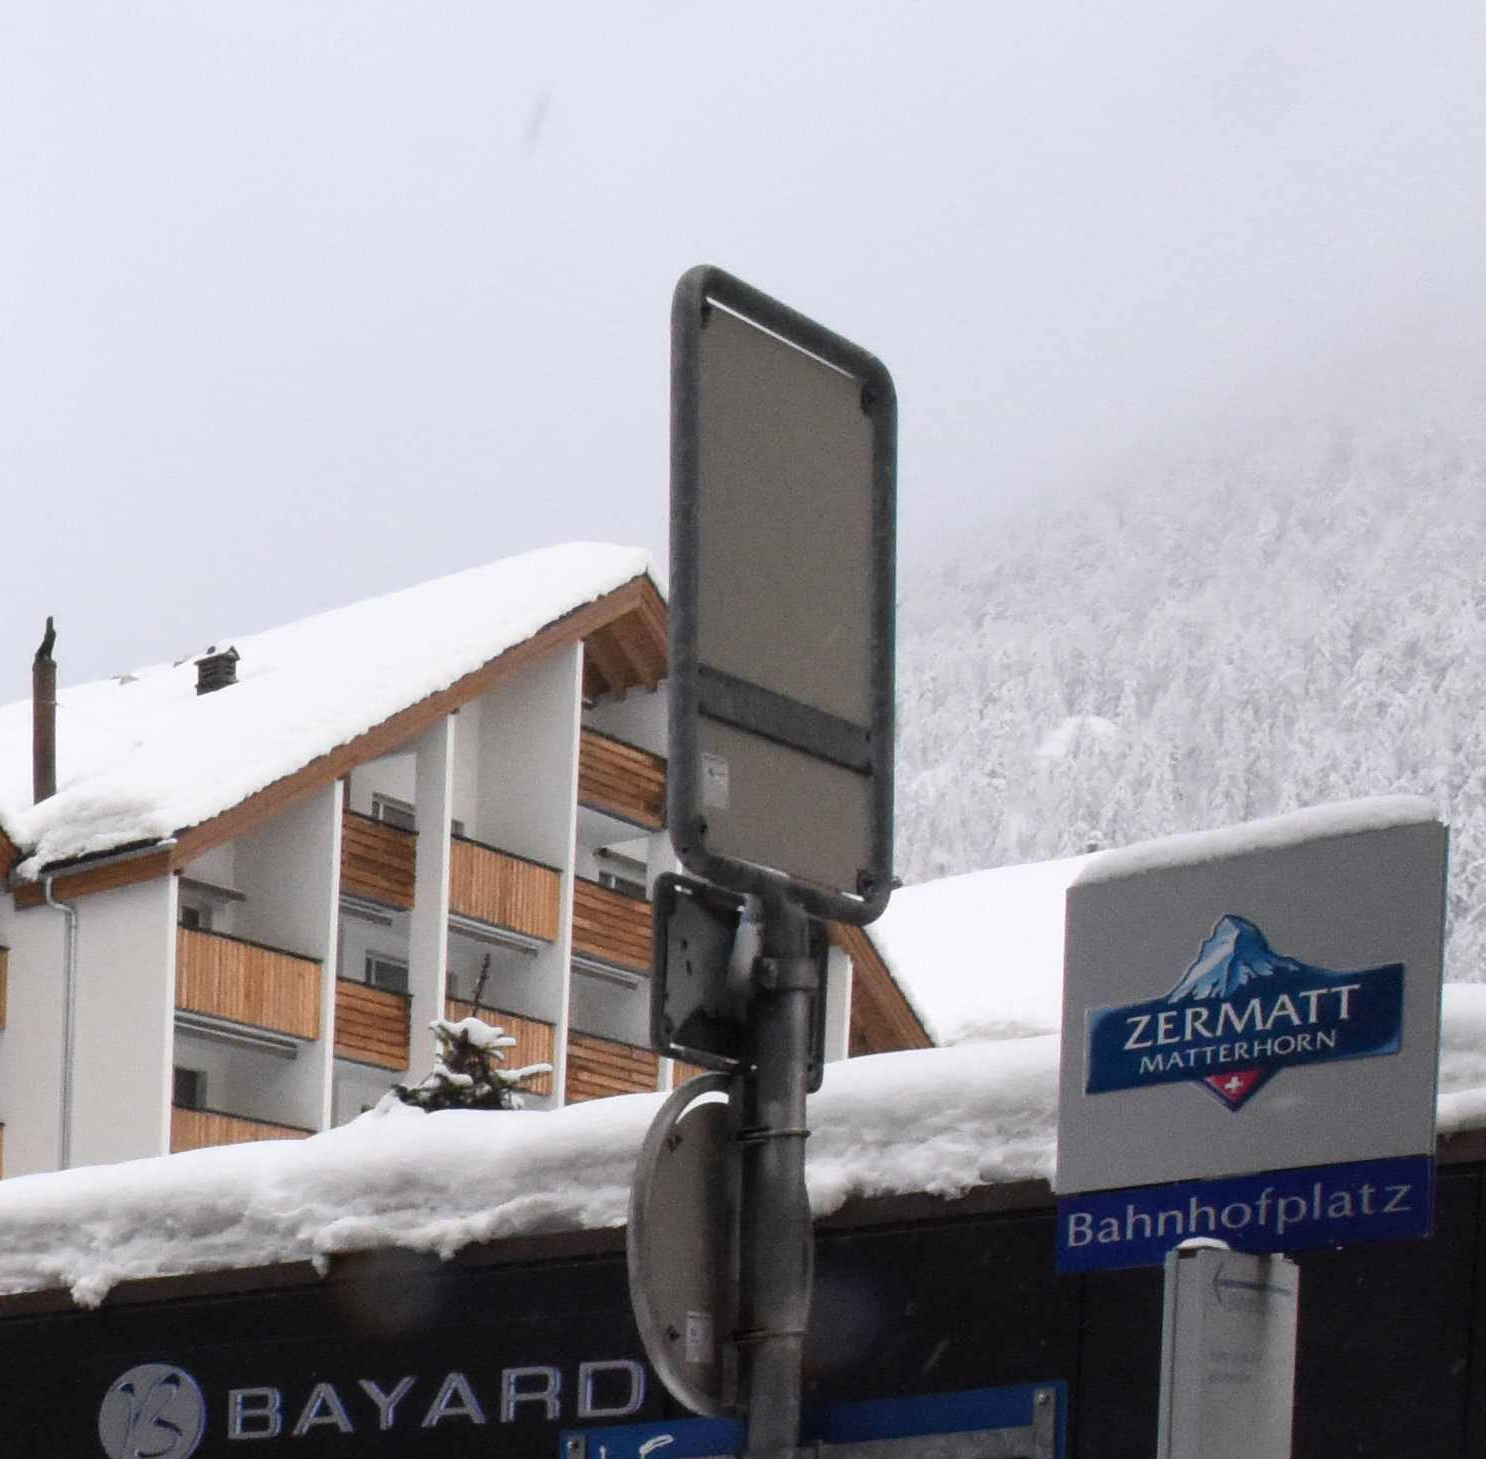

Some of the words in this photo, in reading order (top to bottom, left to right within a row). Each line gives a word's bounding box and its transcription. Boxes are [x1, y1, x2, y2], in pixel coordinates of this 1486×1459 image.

[1124, 984, 1360, 1050] ZERMATT
[1139, 1029, 1338, 1075] MATTERHORN
[1067, 1183, 1412, 1248] Bahnhofplatz
[227, 1359, 645, 1440] BAYARD
